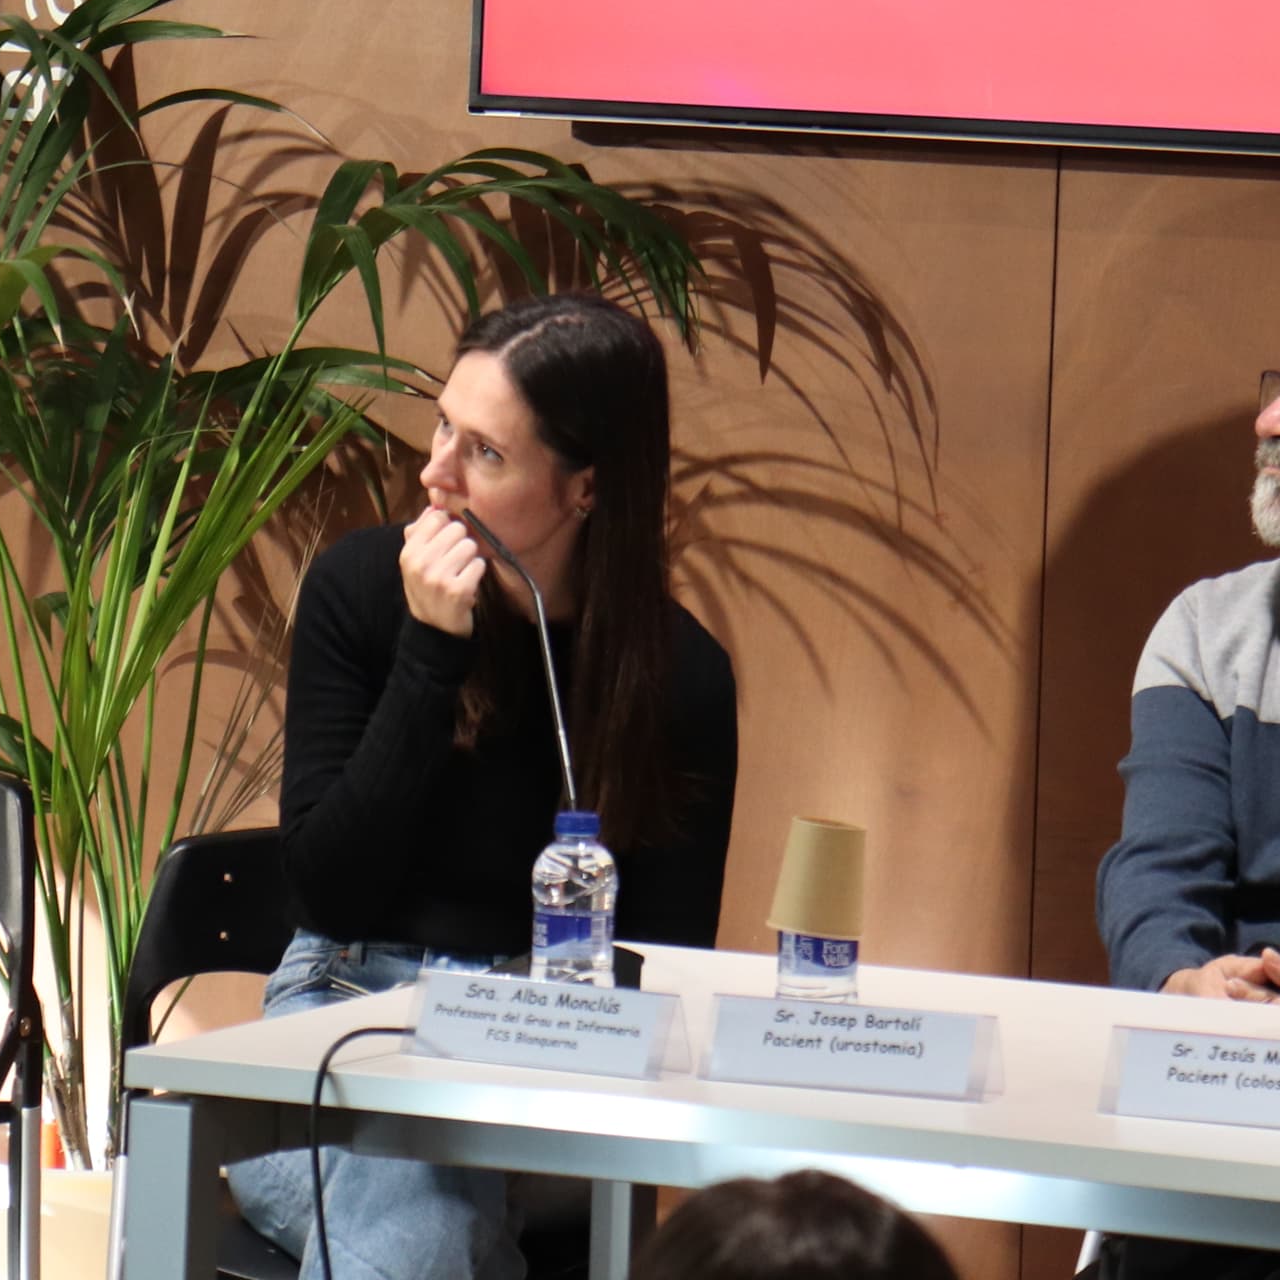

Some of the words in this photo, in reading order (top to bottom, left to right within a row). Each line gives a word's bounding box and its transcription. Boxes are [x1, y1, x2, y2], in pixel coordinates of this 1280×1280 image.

[465, 983, 500, 1001] Sra.
[511, 987, 548, 1007] Alba
[774, 1009, 800, 1025] Sr.
[808, 1010, 858, 1031] Josep
[762, 1031, 823, 1050] Pacient
[829, 1035, 925, 1059] (urostomia)
[1171, 1042, 1198, 1060] Sr.
[1207, 1045, 1257, 1064] Jesús
[1166, 1066, 1228, 1086] Pacient
